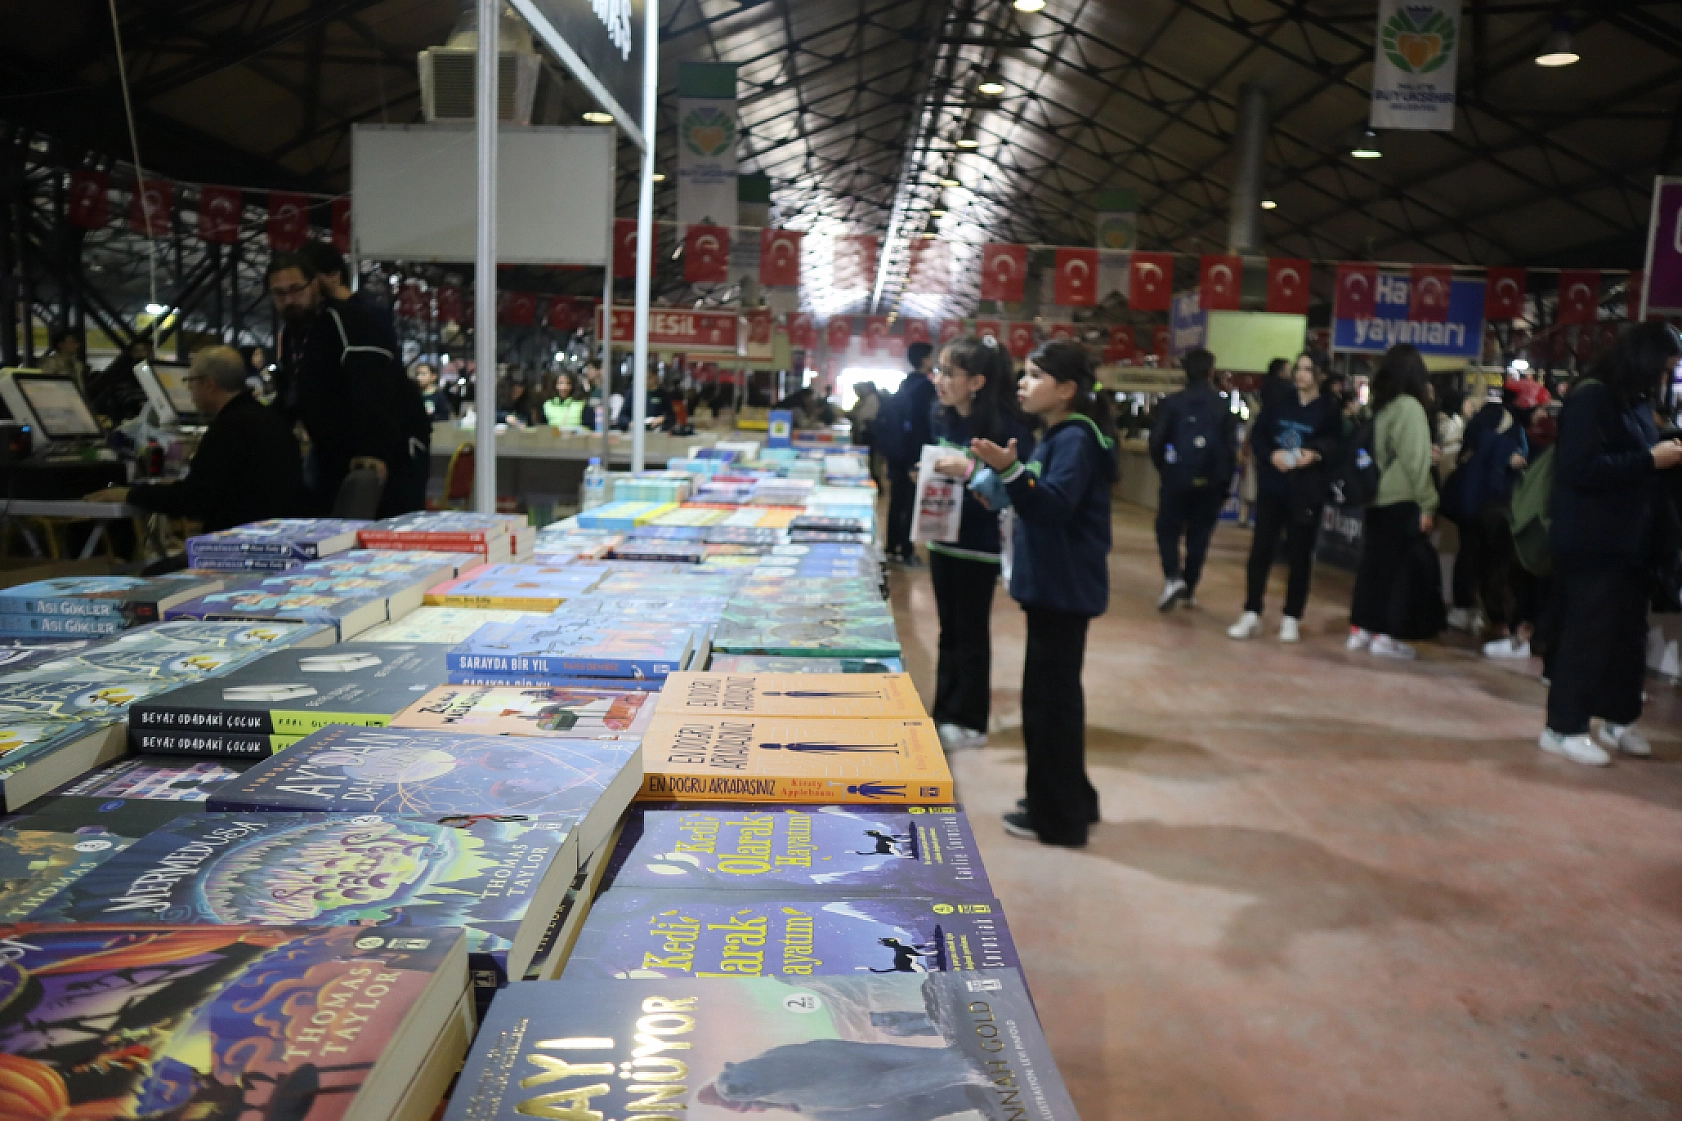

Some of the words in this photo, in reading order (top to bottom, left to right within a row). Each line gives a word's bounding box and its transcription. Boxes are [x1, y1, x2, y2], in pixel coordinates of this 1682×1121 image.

[460, 655, 508, 670] SARAYDA
[511, 655, 529, 671] BİR
[533, 658, 550, 672] YIL
[141, 711, 175, 725] BEYAZ
[177, 711, 223, 727] ODADAKİ
[226, 715, 262, 730] ÇOCUK
[141, 736, 175, 749] BEYAZ
[177, 736, 223, 751] ODADAKİ
[226, 740, 261, 754] ÇOCUK
[650, 776, 666, 792] EN
[669, 776, 706, 793] DOĞRU
[708, 777, 776, 797] ARKADAŞINIZ
[675, 819, 721, 854] Kedi
[717, 815, 775, 875] Olarak
[775, 814, 819, 867] Hayatım
[103, 820, 269, 913] MERMEDUSA
[481, 844, 529, 900] THOMAS
[506, 846, 550, 898] TAYLOR
[642, 920, 701, 973] Kedi
[695, 915, 768, 978] larak
[777, 916, 823, 976] ayatım
[282, 968, 372, 1062] THOMAS
[319, 971, 403, 1057] TAYLOR
[968, 1001, 1006, 1053] GOLD
